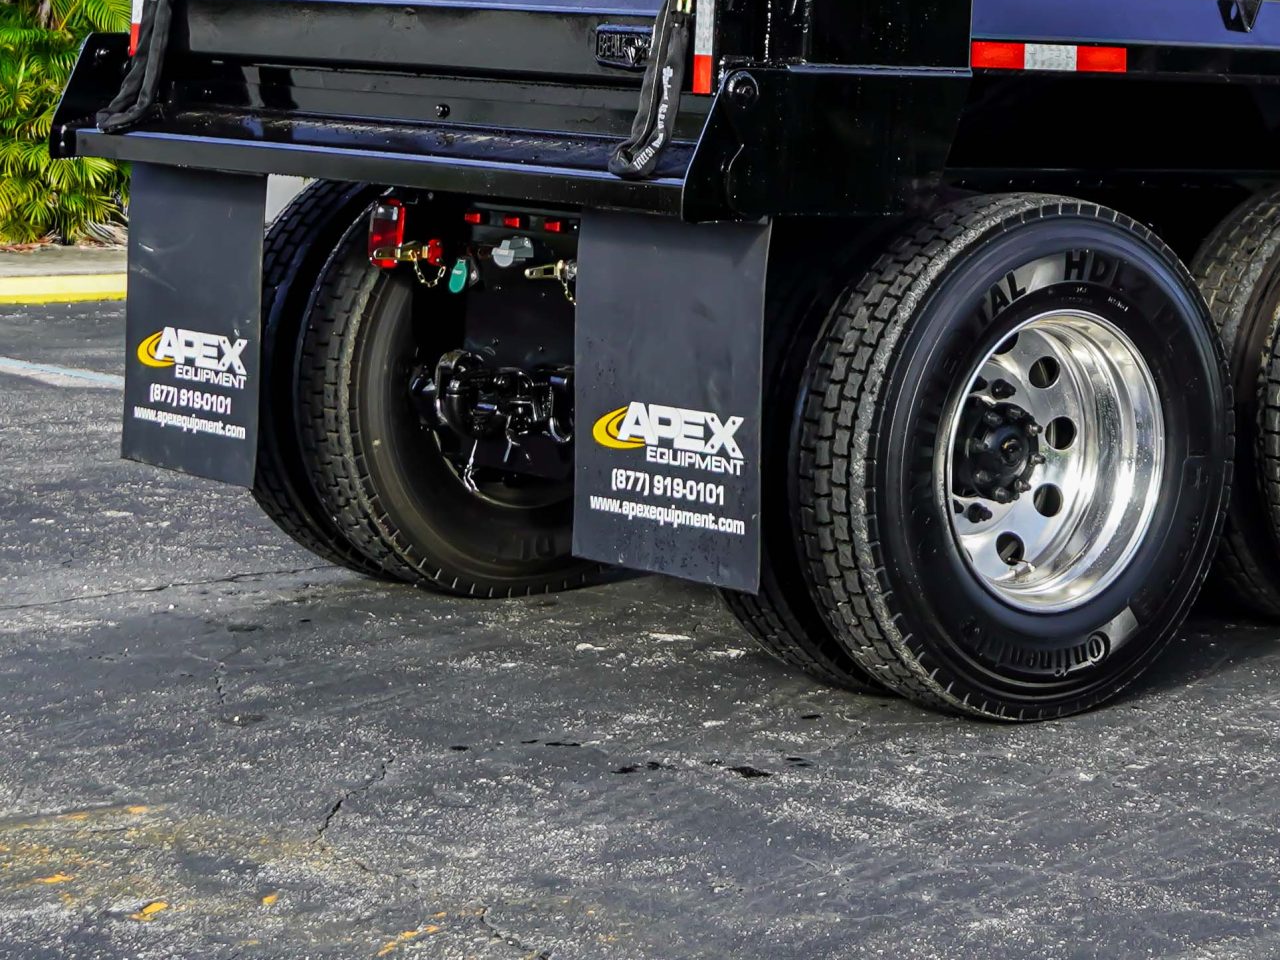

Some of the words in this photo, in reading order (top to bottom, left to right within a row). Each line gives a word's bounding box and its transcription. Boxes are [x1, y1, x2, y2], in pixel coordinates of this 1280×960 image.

[154, 326, 248, 375] APEX
[175, 365, 247, 389] EQUIPMENT
[149, 383, 178, 407] (877)
[180, 389, 231, 415] 919-0101
[134, 406, 246, 440] www.apexequipment.com
[617, 401, 745, 459] APEX
[646, 446, 745, 475] EQUIPMENT
[611, 468, 650, 496] (877)
[653, 475, 725, 505] 919-0101
[590, 495, 745, 535] www.apexequipment.com
